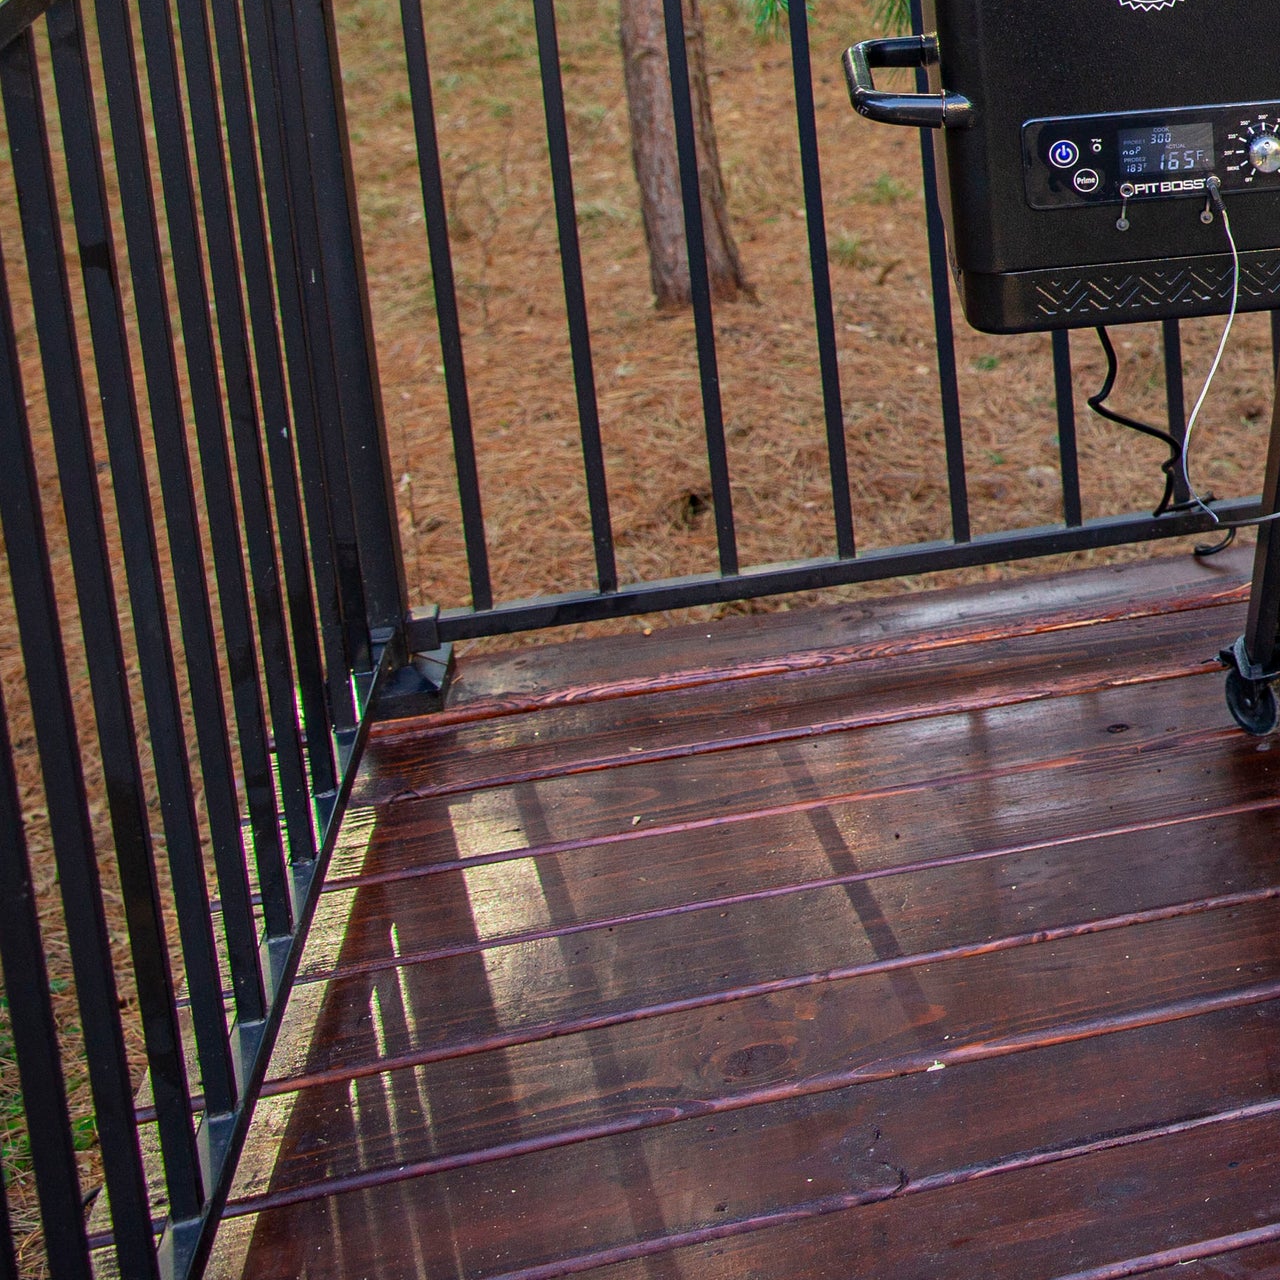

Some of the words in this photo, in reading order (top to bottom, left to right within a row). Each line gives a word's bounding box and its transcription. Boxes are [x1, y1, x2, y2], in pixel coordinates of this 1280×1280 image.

[1150, 133, 1172, 144] 300
[1077, 177, 1096, 185] Prime
[1134, 182, 1159, 194] PIT
